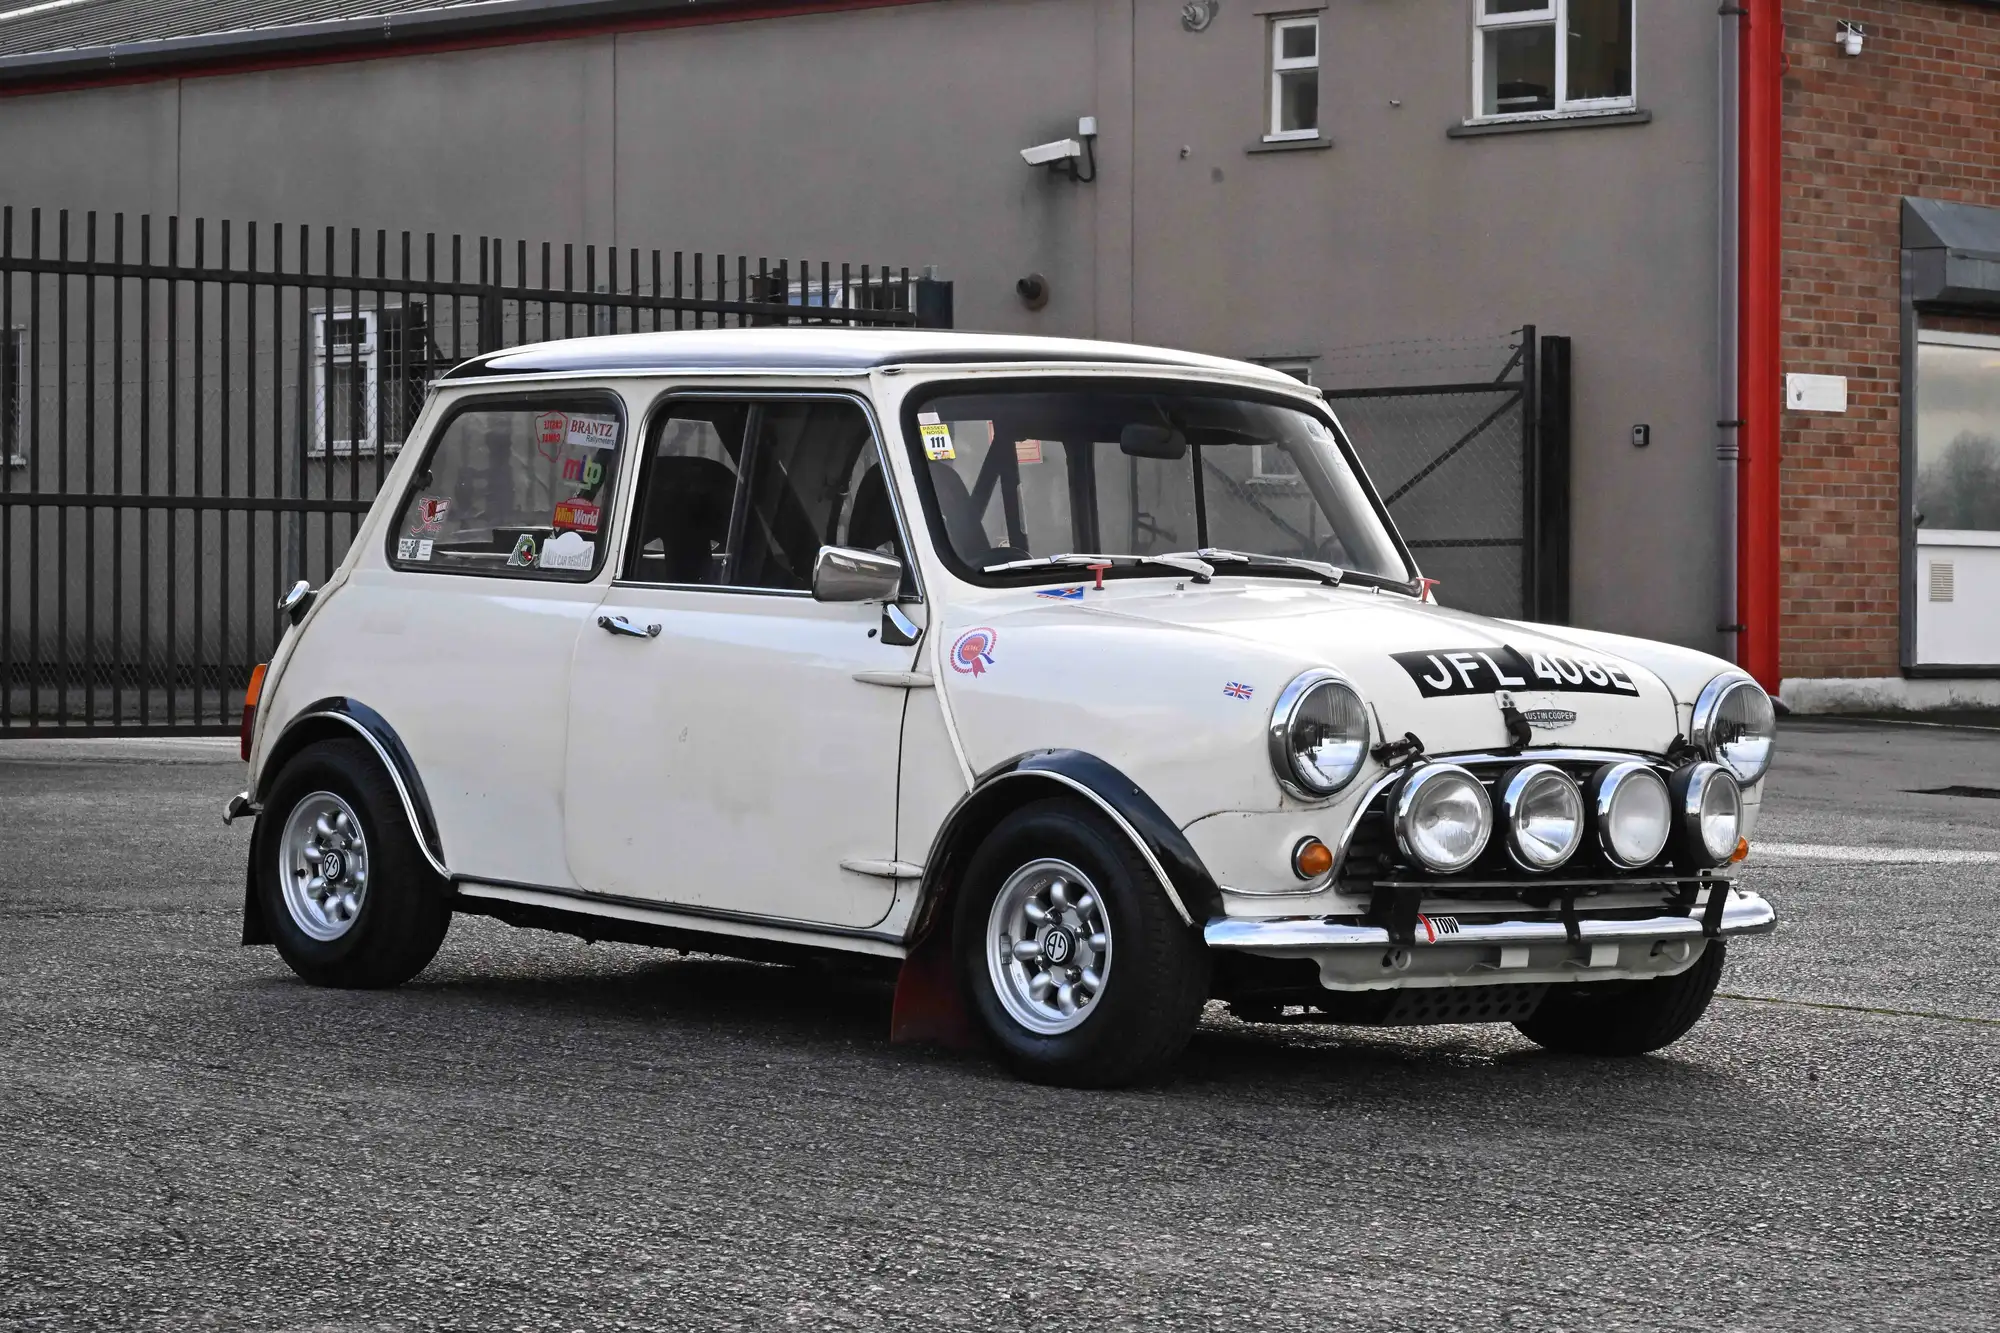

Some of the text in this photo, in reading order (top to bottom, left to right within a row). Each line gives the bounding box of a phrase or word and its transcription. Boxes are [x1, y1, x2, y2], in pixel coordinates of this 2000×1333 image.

[570, 419, 613, 437] BRANTZ
[585, 434, 615, 446] Rallymeters
[930, 436, 946, 448] 111
[557, 554, 568, 566] CAR
[1423, 651, 1637, 692] JFL 408E
[1548, 711, 1575, 721] COOPER
[1432, 917, 1460, 934] TOW
